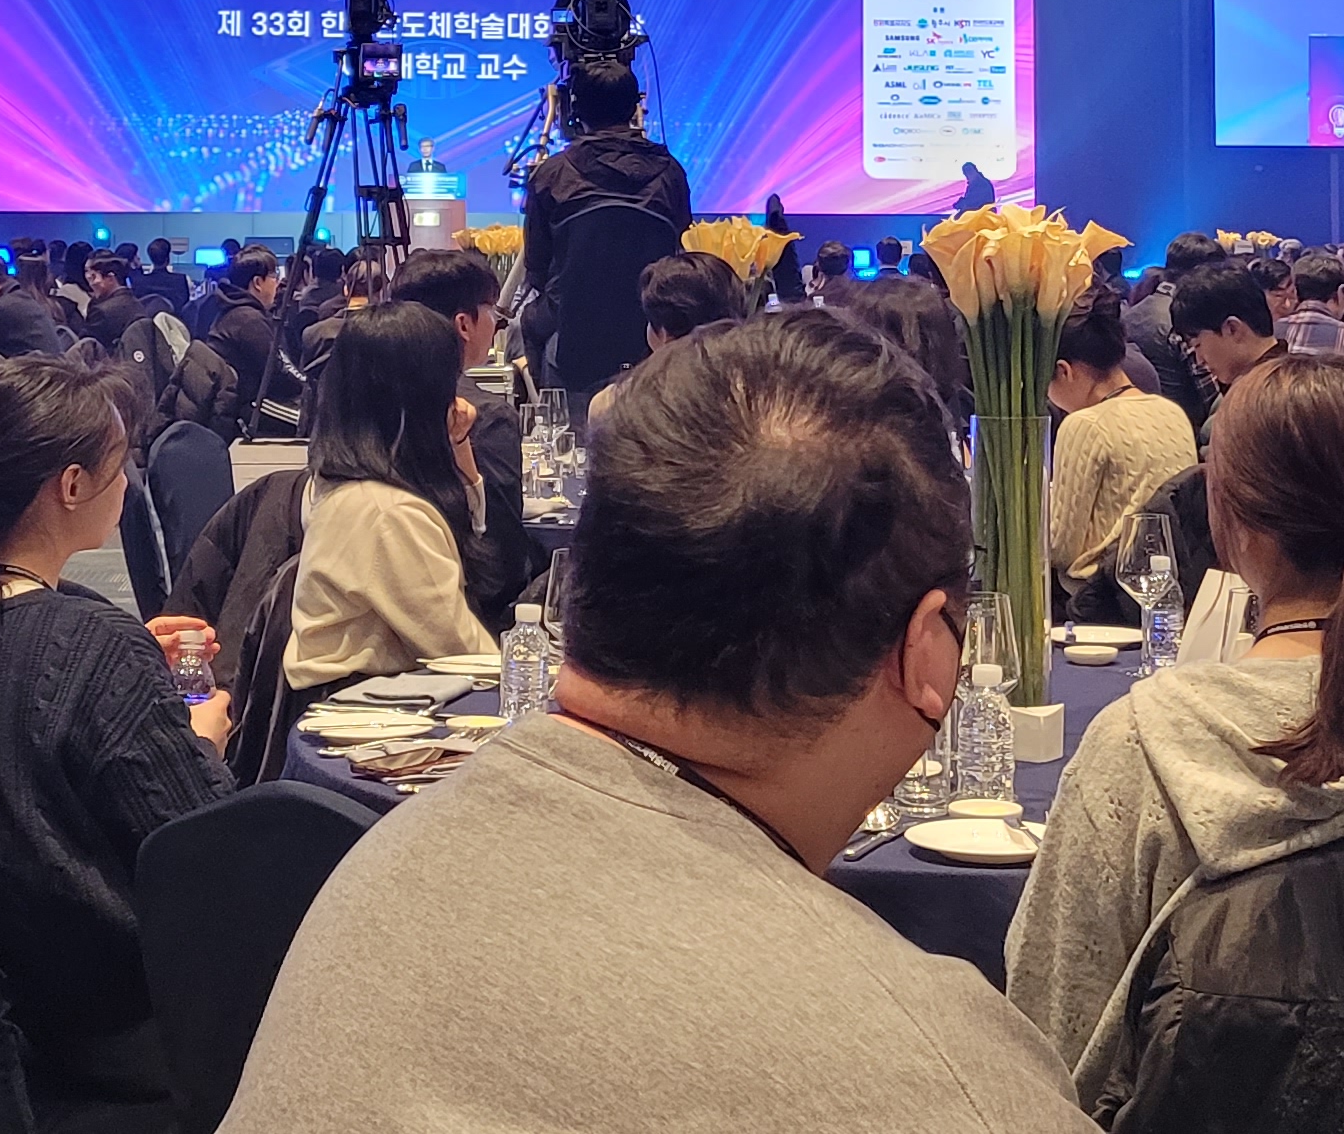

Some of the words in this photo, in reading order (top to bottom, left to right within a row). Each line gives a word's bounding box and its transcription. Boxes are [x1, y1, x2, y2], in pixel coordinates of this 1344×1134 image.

[217, 10, 242, 38] 제
[250, 10, 312, 38] 33회
[885, 34, 921, 42] SAMSUNG
[475, 53, 529, 81] 교수
[884, 81, 907, 89] ASML
[977, 79, 994, 88] TEL
